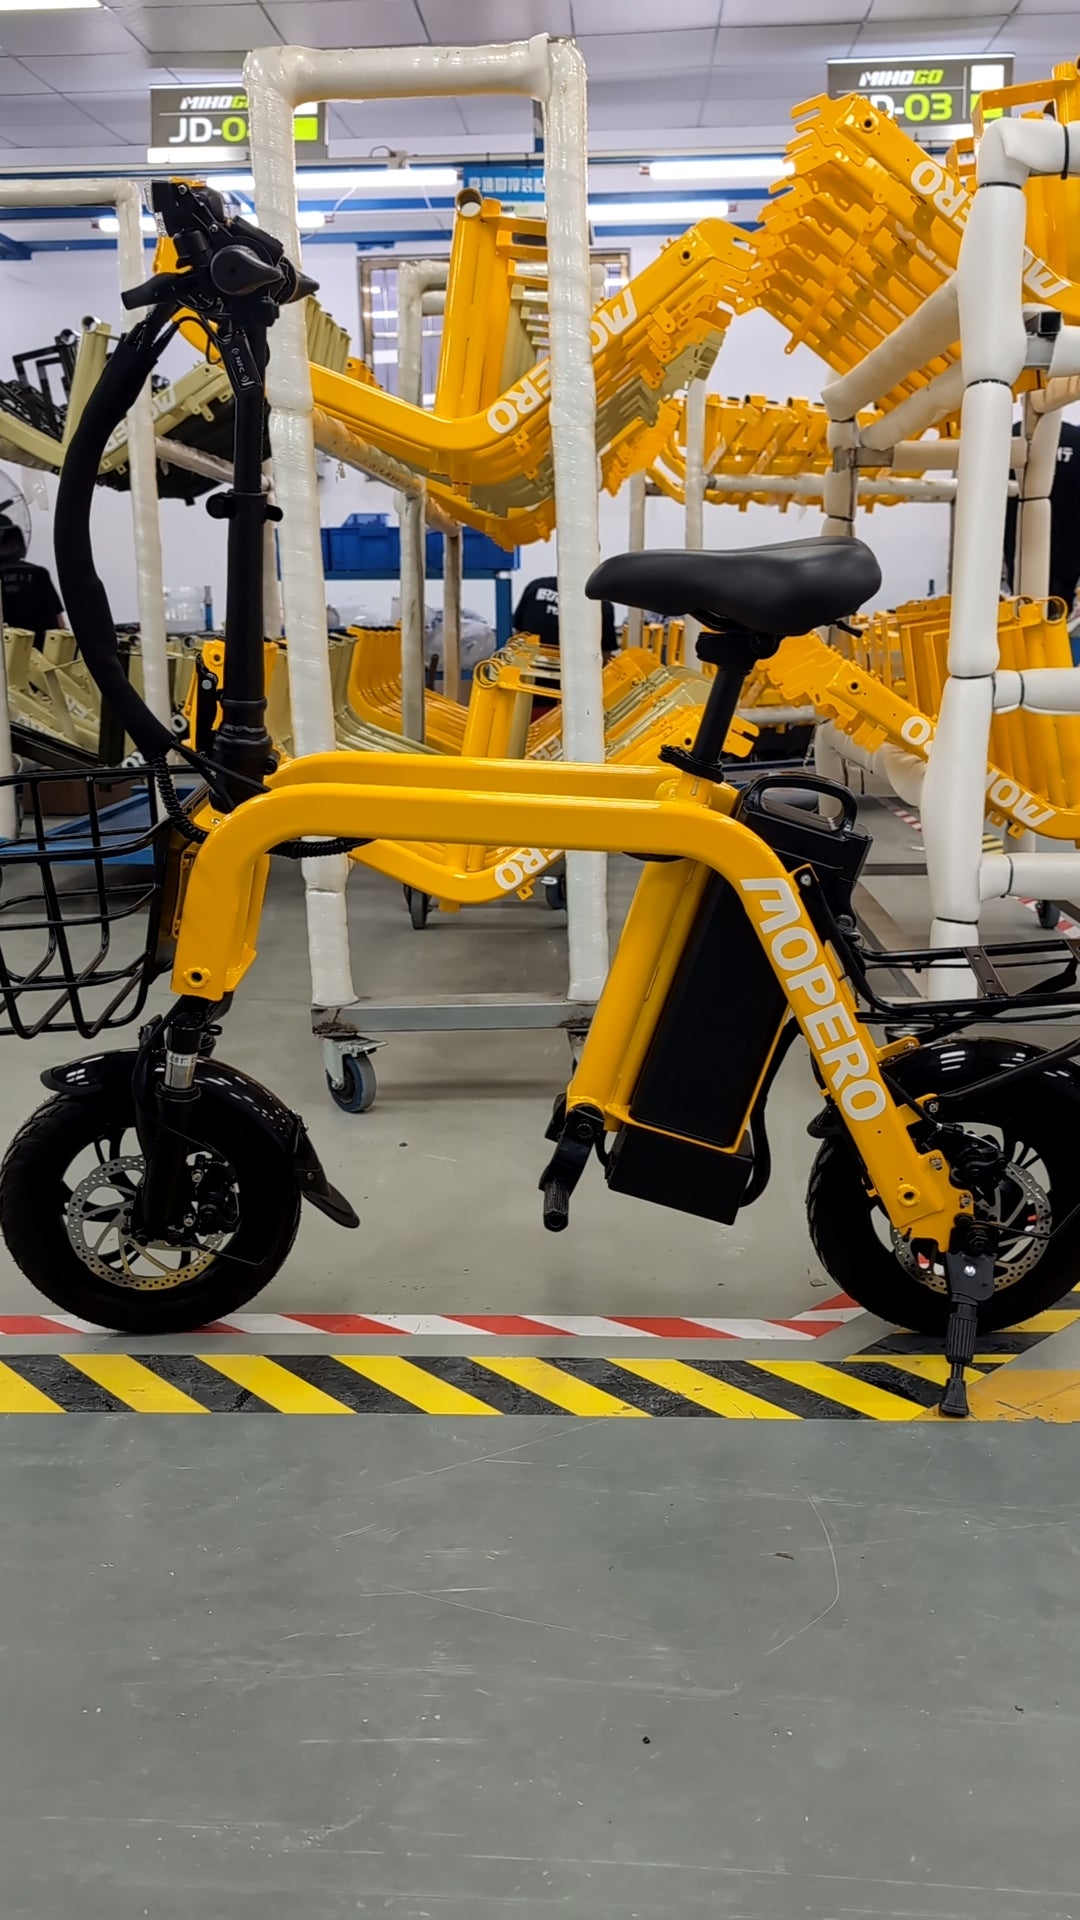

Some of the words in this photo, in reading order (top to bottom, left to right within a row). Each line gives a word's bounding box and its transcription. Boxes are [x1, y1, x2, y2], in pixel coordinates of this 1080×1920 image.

[858, 69, 944, 86] MIHOGO
[180, 95, 249, 110] MIHOG
[868, 92, 953, 121] D-03
[168, 116, 250, 143] JD-0
[740, 877, 886, 1121] MOPERO
